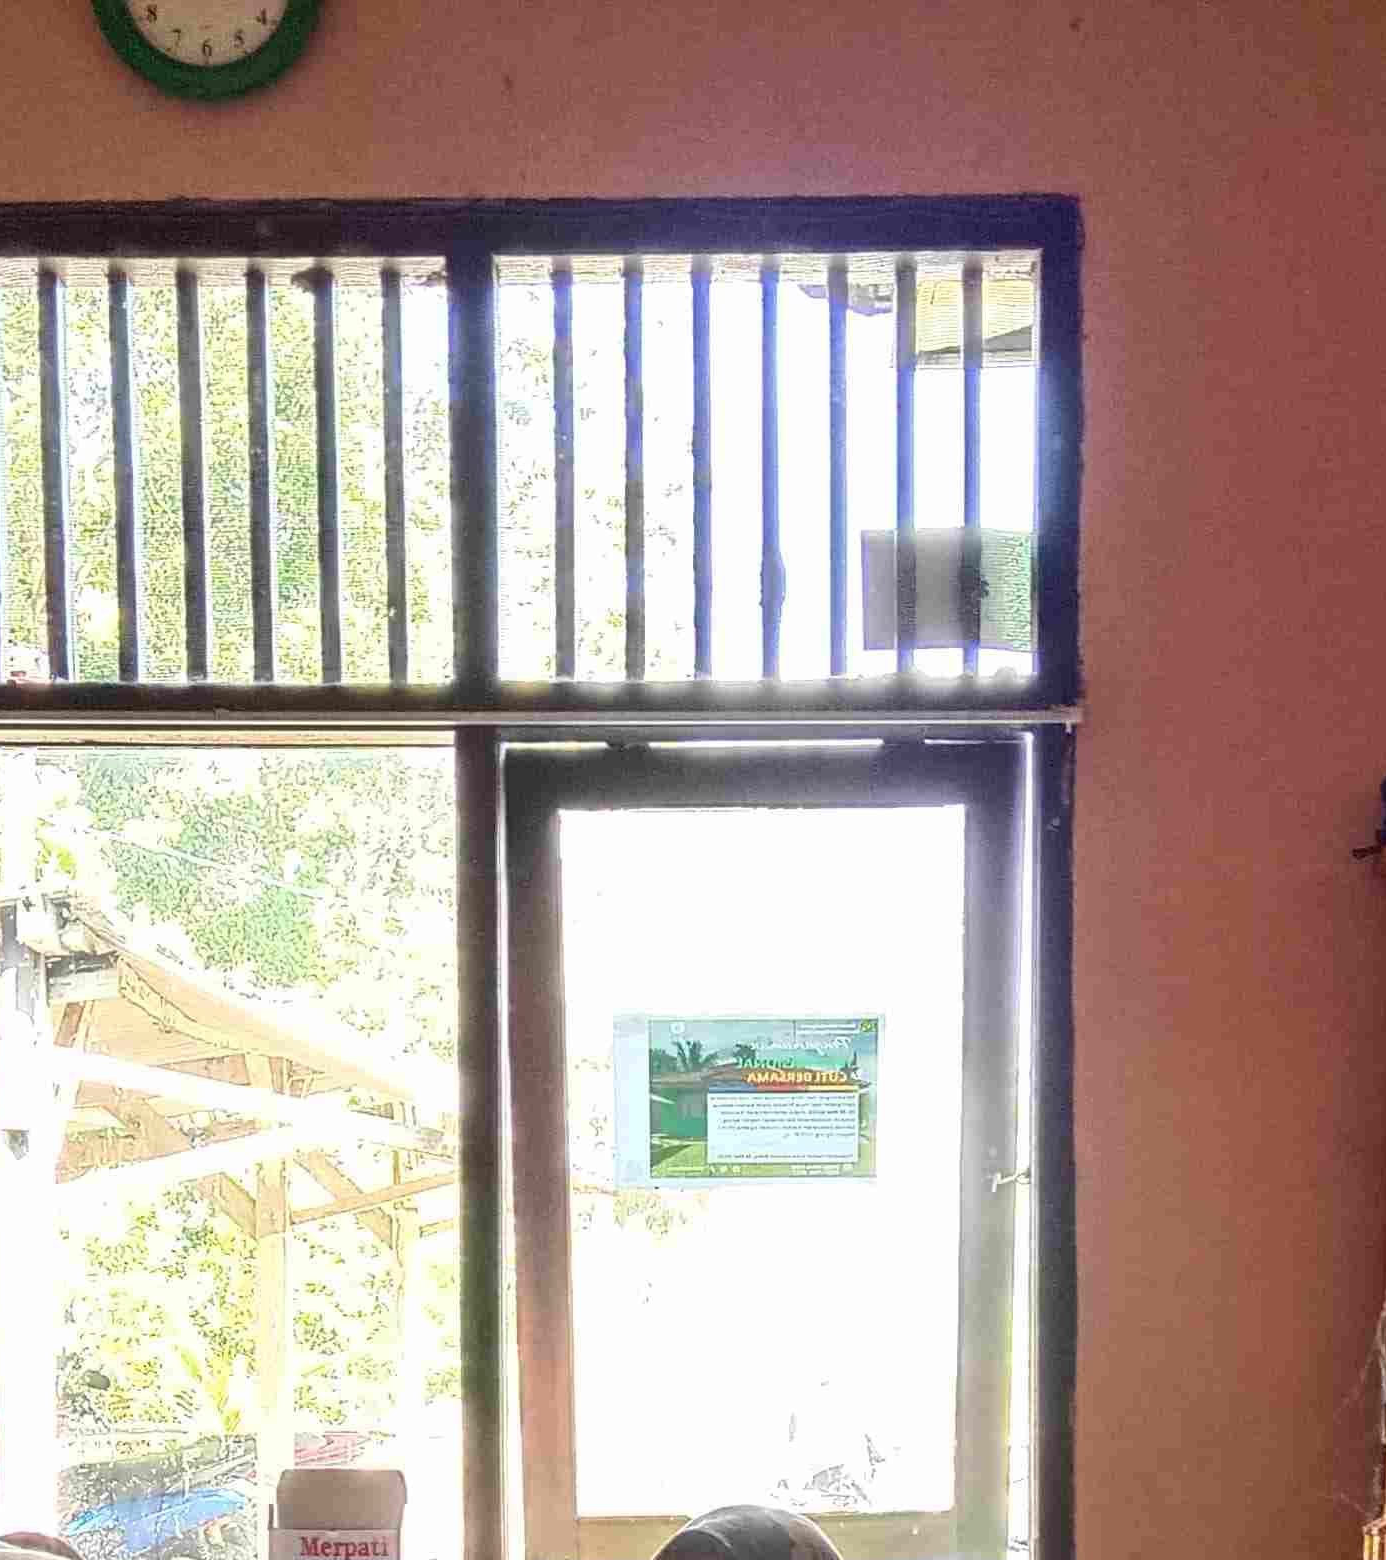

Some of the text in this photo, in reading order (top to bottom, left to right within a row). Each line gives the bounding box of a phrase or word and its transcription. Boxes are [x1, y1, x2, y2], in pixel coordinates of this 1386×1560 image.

[146, 4, 158, 23] 8
[255, 8, 267, 25] 4
[172, 28, 182, 47] 7
[201, 38, 213, 57] 6
